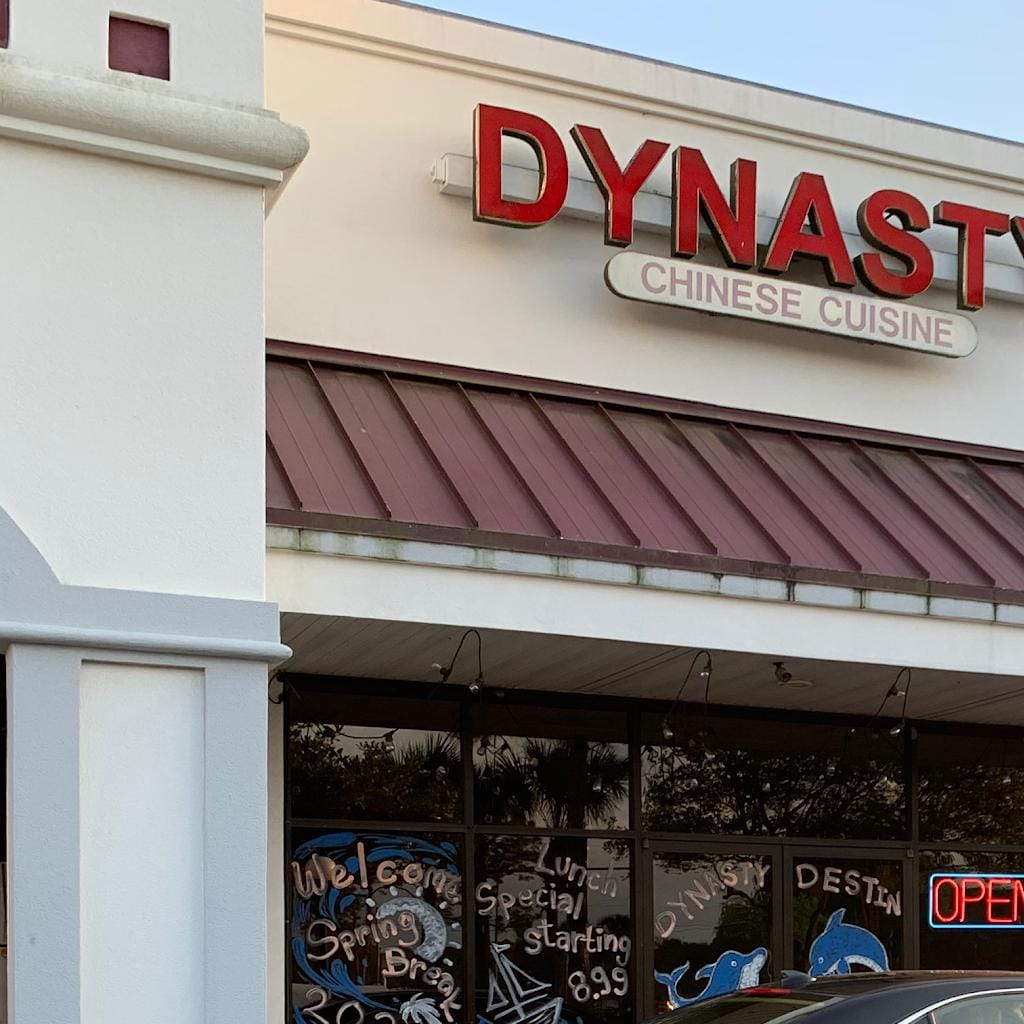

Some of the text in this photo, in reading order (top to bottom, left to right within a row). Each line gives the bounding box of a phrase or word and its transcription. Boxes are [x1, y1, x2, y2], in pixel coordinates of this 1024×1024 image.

[640, 261, 954, 348] CHINESE CUISINE
[291, 842, 463, 903] Welcome
[534, 837, 618, 898] Lunch
[796, 863, 902, 916] DESTIN
[475, 881, 585, 921] Special
[655, 862, 771, 938] DYNASTY
[307, 911, 420, 961] Spring
[382, 947, 462, 1022] Break
[567, 966, 629, 1002] 8.99
